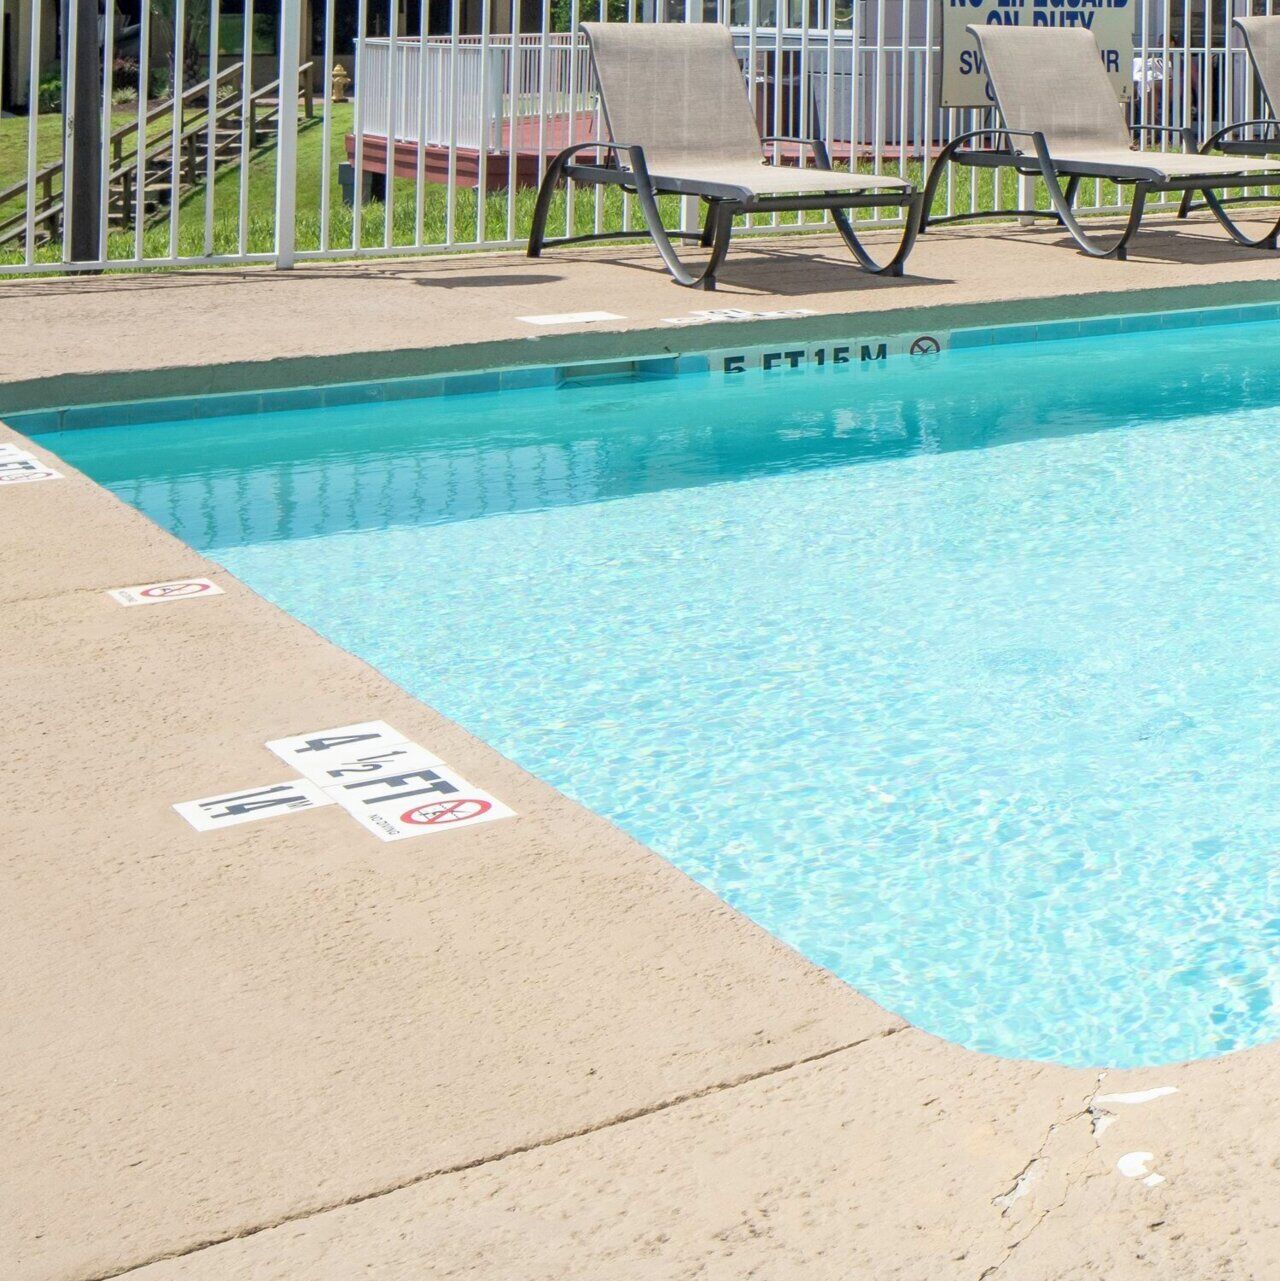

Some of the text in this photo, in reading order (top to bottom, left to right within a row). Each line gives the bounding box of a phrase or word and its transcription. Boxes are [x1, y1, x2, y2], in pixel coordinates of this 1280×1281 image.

[763, 350, 805, 370] FT
[861, 344, 887, 361] M
[295, 733, 382, 754] 4
[343, 769, 460, 805] FT
